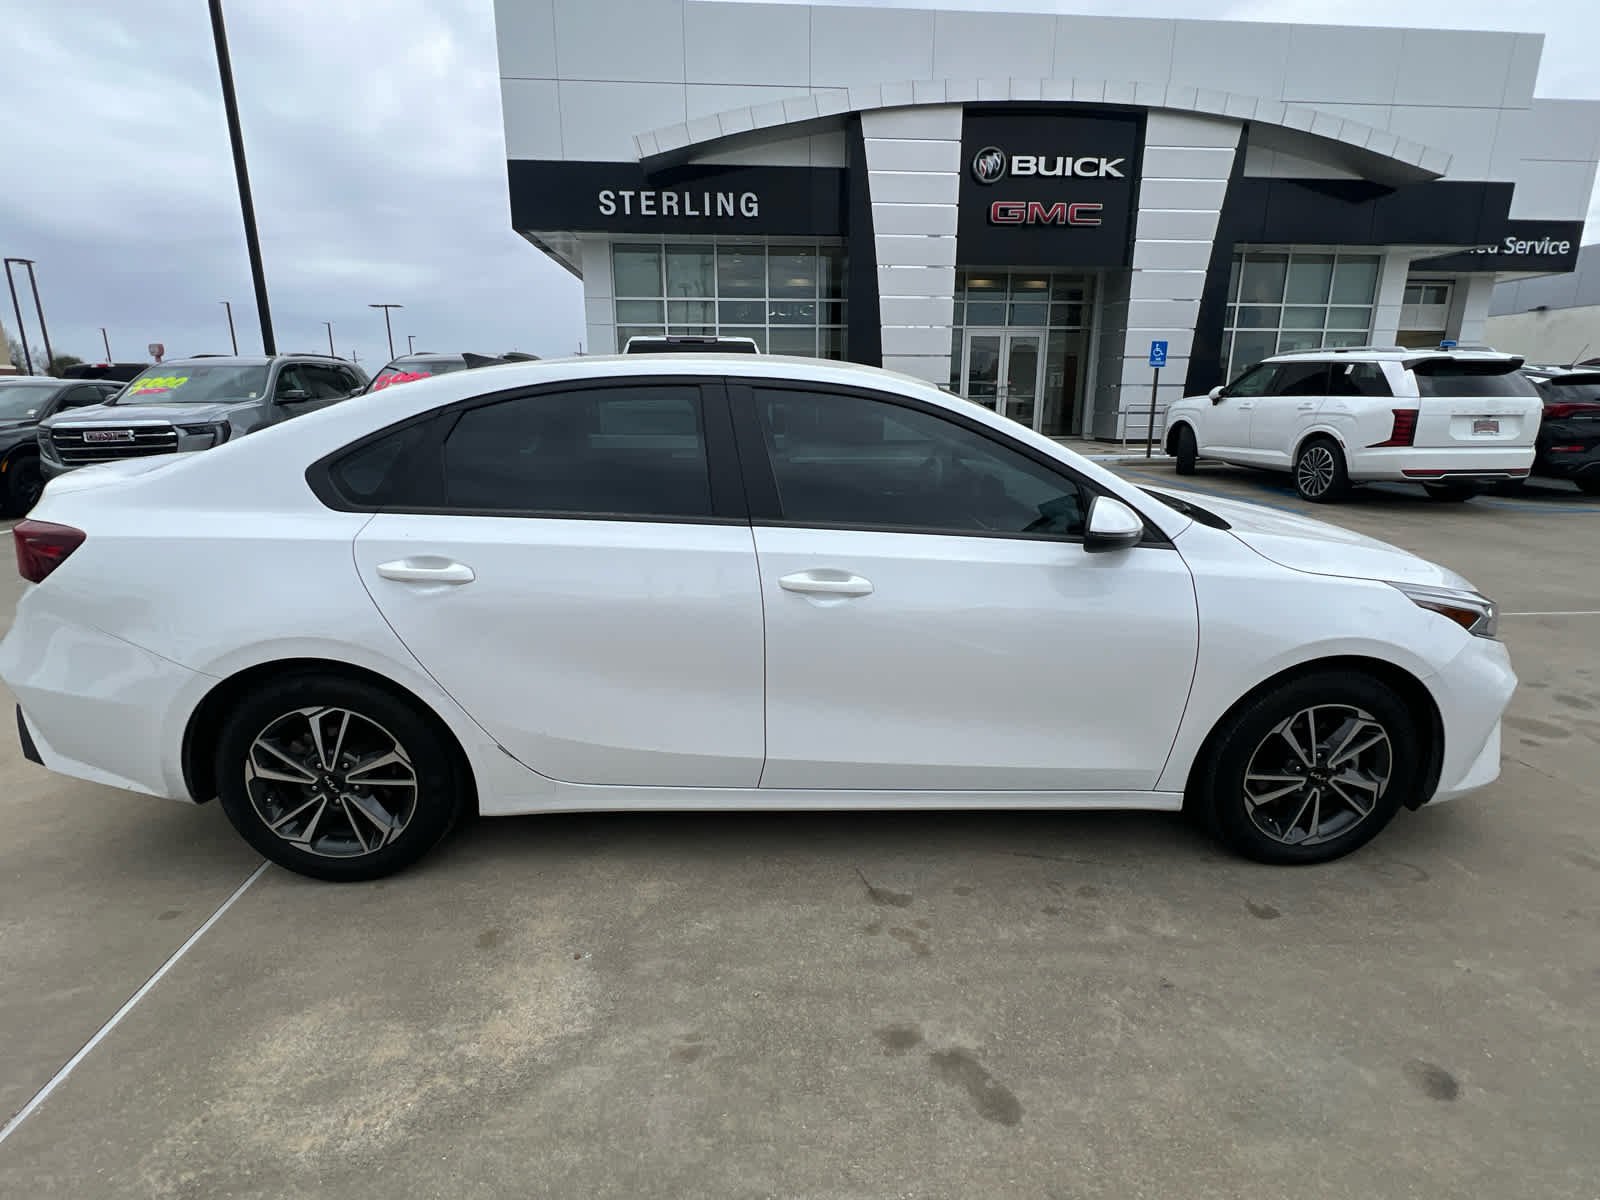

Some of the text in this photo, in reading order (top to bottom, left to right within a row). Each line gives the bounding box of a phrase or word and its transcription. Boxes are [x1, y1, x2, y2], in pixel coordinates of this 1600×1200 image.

[1011, 155, 1126, 178] BUICK
[598, 190, 759, 217] STERLING
[991, 201, 1104, 225] GMC
[1503, 236, 1570, 255] Service
